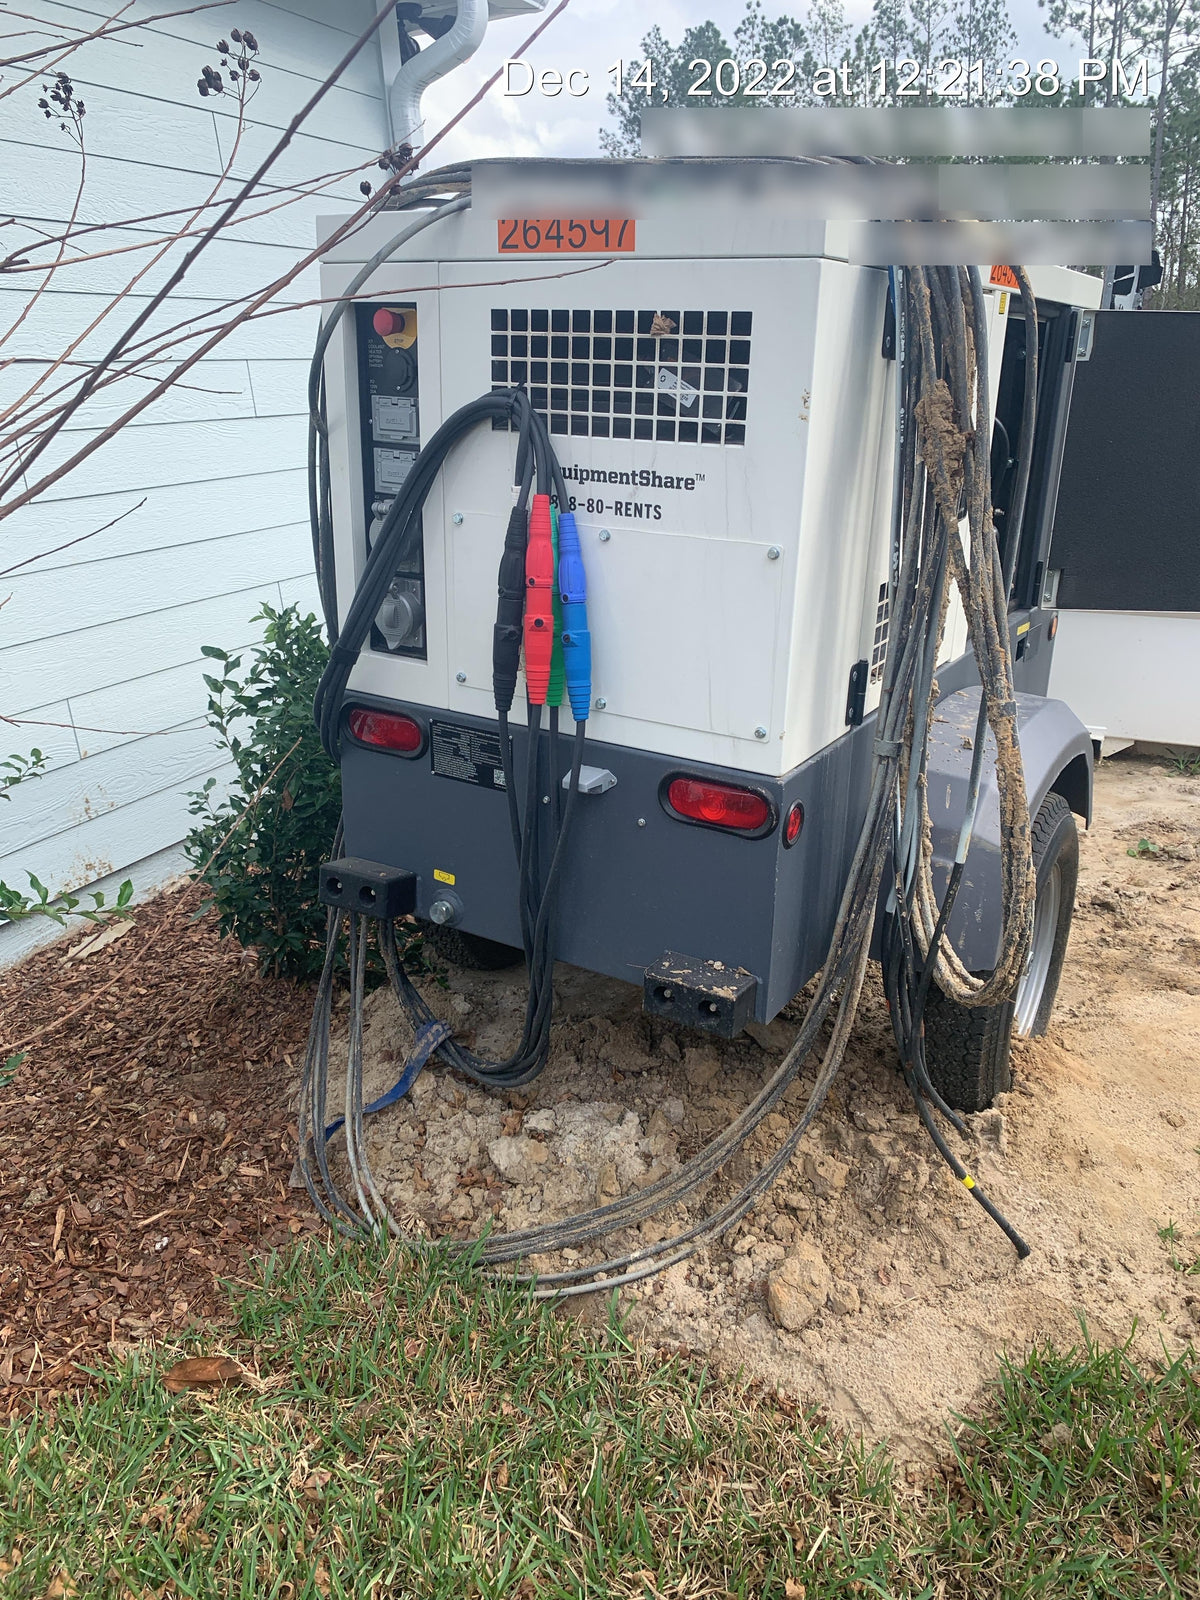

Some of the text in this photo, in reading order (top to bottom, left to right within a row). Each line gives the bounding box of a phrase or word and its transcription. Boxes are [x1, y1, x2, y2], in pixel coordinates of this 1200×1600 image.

[500, 219, 630, 249] 264597
[560, 464, 705, 491] uipmentShare™
[550, 494, 662, 520] 88-80-RENTS
